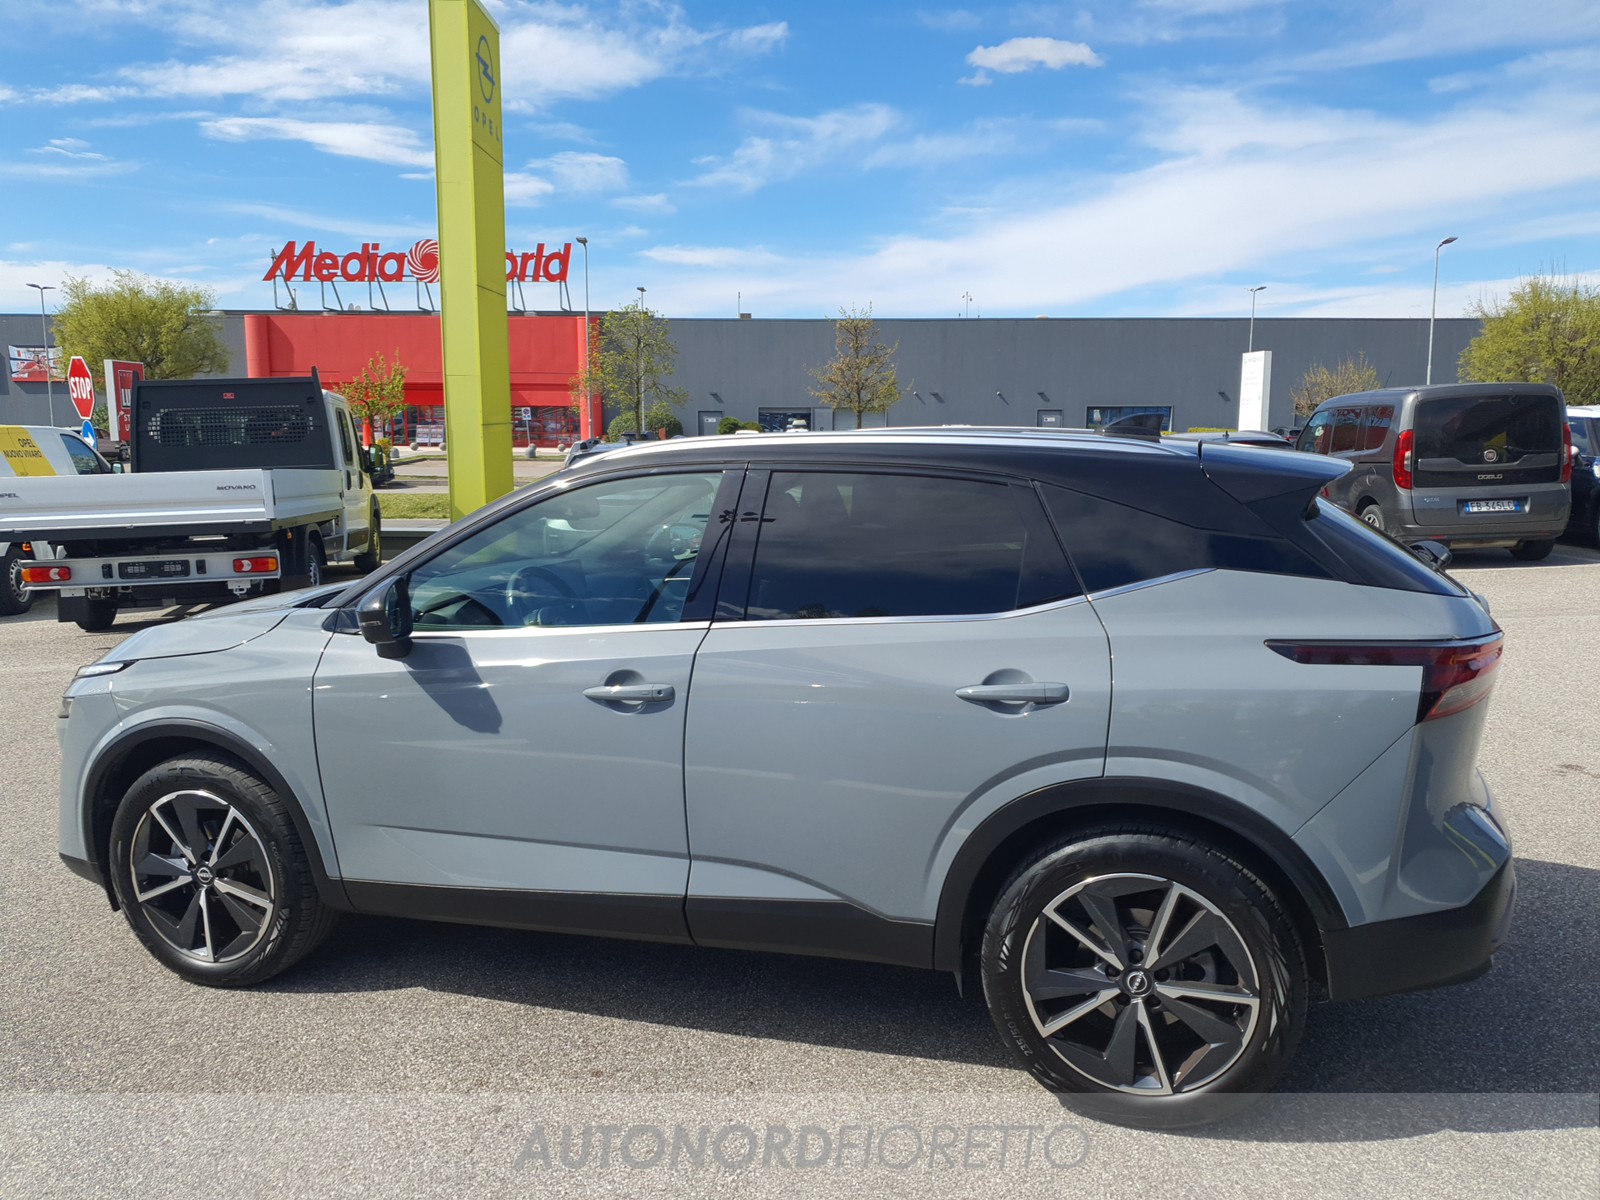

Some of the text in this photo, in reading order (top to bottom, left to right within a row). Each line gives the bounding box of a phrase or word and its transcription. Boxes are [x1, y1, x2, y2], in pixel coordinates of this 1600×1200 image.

[474, 105, 500, 142] OPEL
[262, 241, 572, 282] Media orld
[70, 376, 91, 399] STOP
[18, 438, 35, 448] OPEL
[3, 450, 42, 458] NUOVO VIVARO
[1470, 502, 1482, 511] FB
